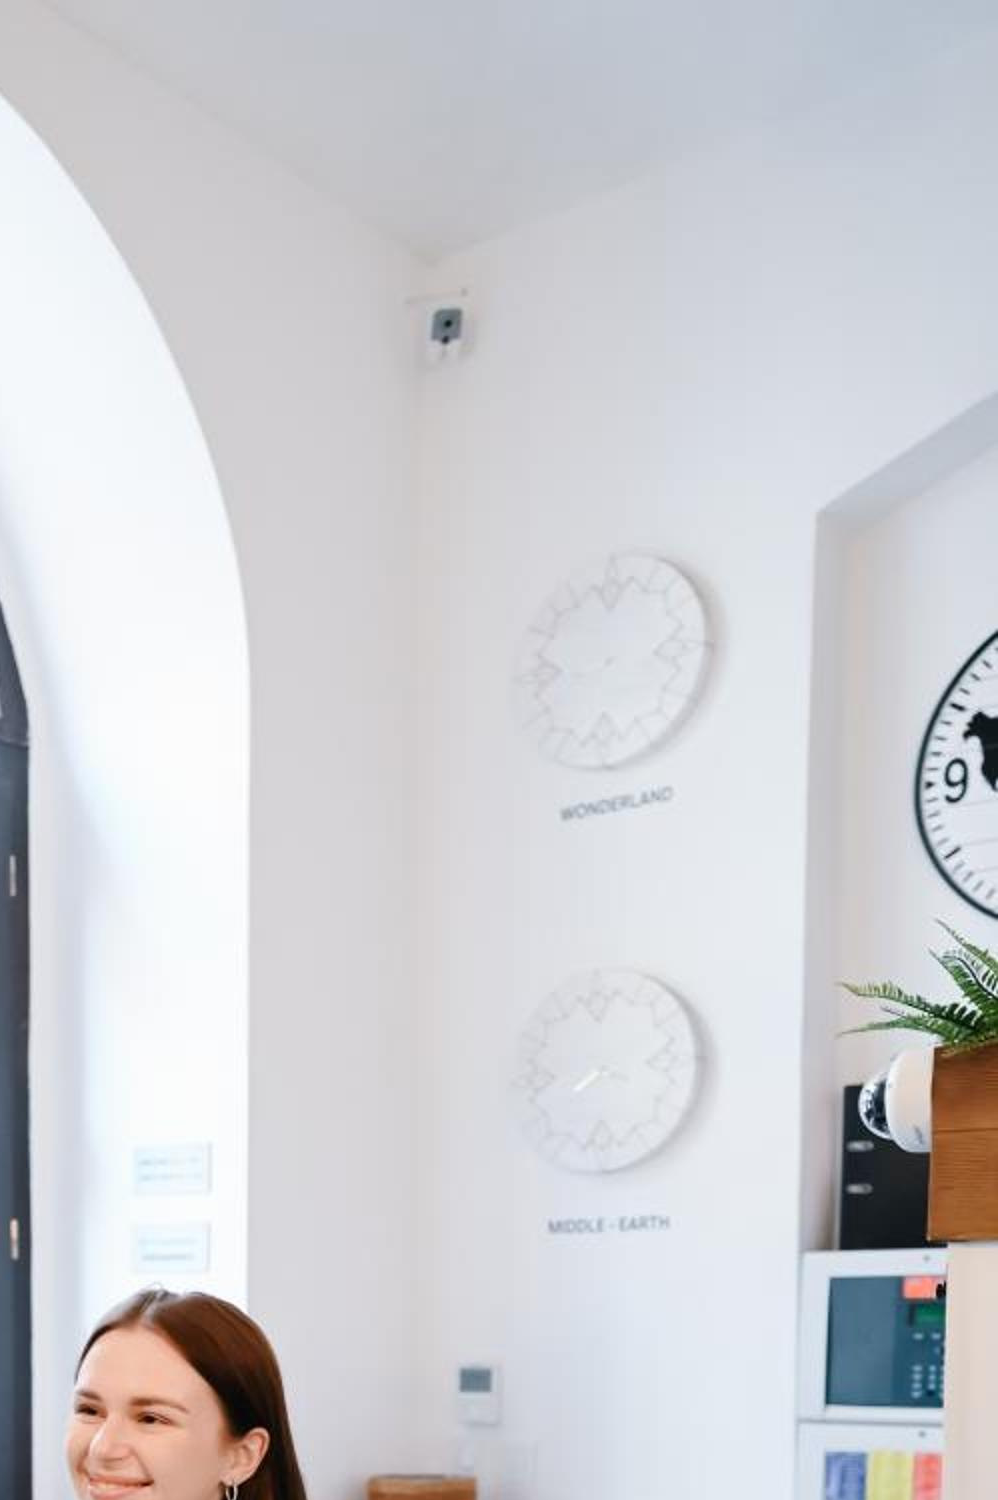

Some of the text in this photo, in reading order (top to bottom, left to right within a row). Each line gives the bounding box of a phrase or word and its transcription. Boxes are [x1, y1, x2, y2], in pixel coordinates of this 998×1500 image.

[944, 757, 969, 804] 9
[559, 785, 674, 820] WONDERLAND
[547, 1217, 604, 1234] MIDDLE
[618, 1214, 670, 1233] EARTH
